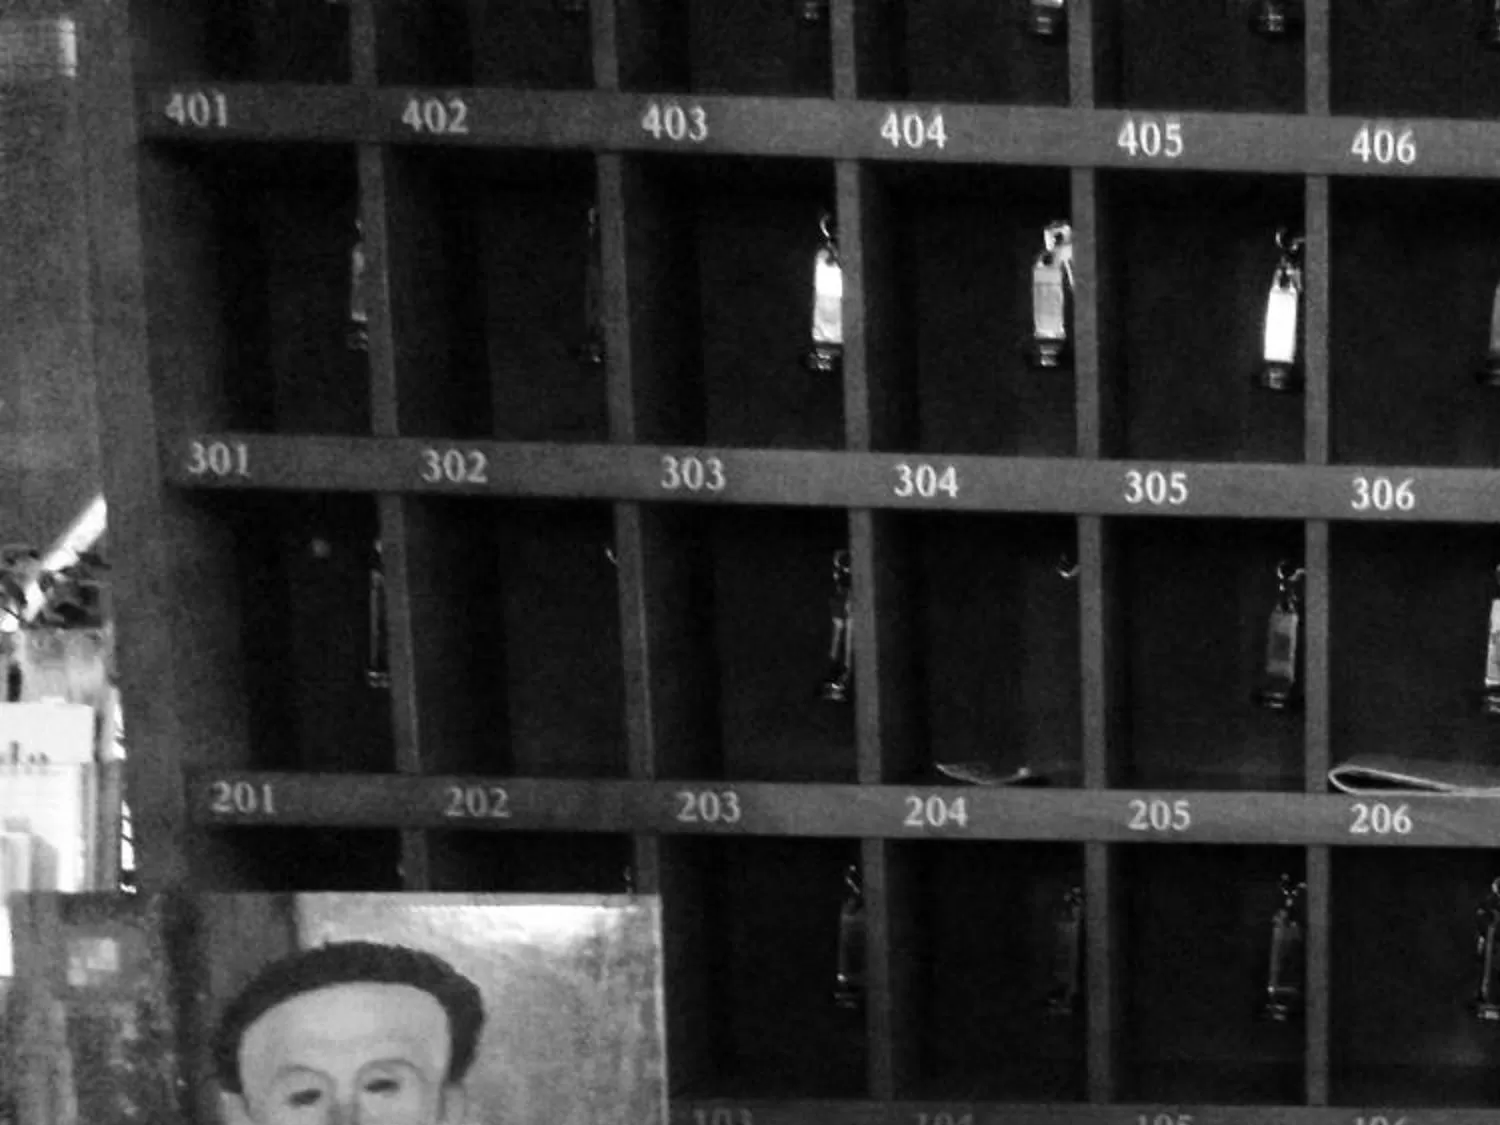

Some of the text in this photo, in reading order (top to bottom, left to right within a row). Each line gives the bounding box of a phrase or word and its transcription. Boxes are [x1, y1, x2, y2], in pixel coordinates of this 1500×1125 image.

[164, 92, 227, 127] 401
[402, 98, 468, 133] 402
[643, 104, 708, 140] 403
[881, 112, 947, 148] 404
[1118, 120, 1183, 157] 405
[1351, 128, 1416, 164] 406
[186, 441, 247, 474] 301
[421, 449, 487, 483] 302
[661, 456, 726, 490] 303
[894, 463, 959, 498] 304
[1125, 470, 1188, 504] 305
[1352, 477, 1415, 510] 306
[212, 780, 274, 813] 201
[446, 786, 508, 817] 202
[678, 791, 741, 822] 203
[905, 795, 967, 826] 204
[1129, 799, 1191, 830] 205
[1350, 803, 1412, 833] 206
